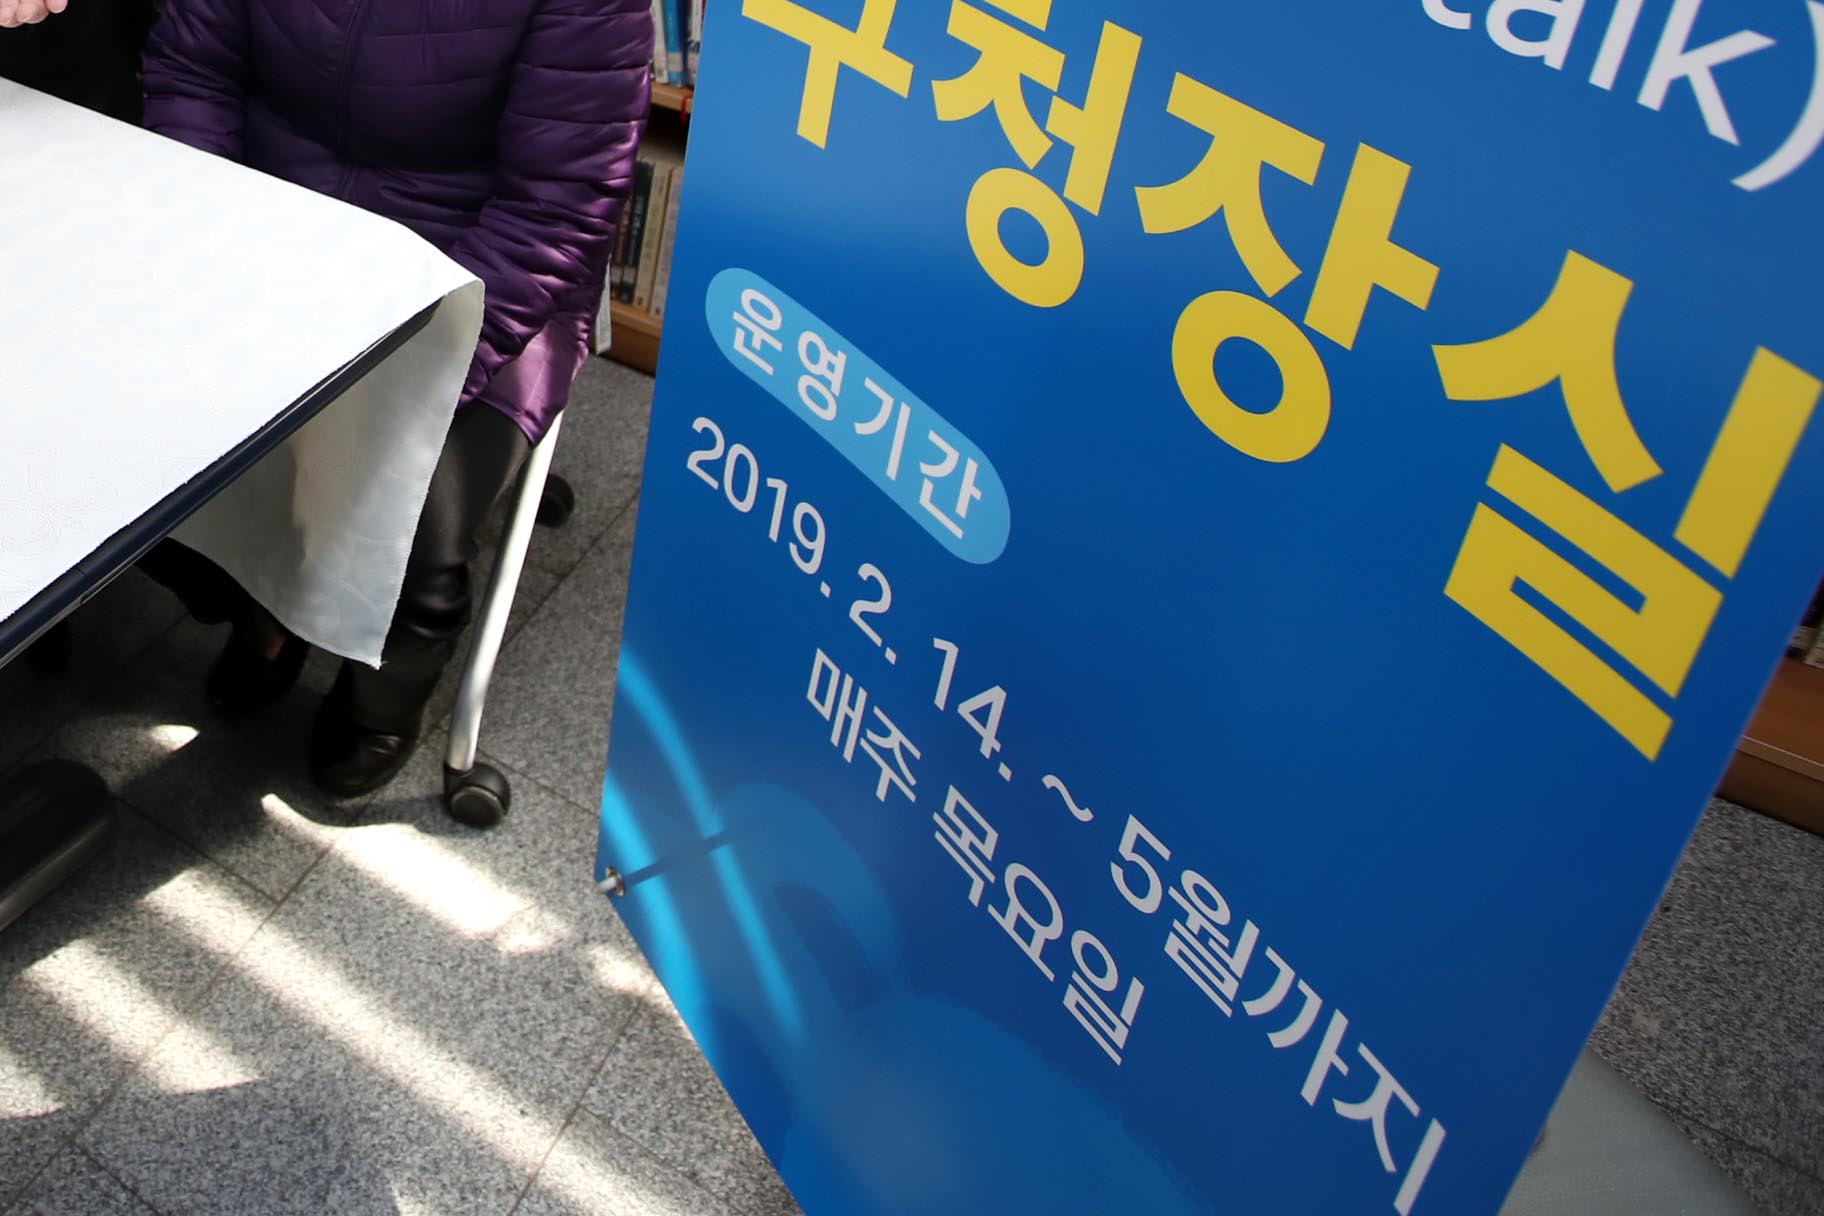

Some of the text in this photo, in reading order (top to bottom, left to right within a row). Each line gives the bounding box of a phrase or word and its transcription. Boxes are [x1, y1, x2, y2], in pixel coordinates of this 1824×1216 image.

[732, 288, 982, 539] 운영기간
[686, 417, 831, 598] 2019.
[849, 563, 897, 664] 2.
[933, 637, 1012, 782] 14.
[1110, 814, 1446, 1216] 5월까지
[807, 648, 1145, 1066] 매주 목요일
